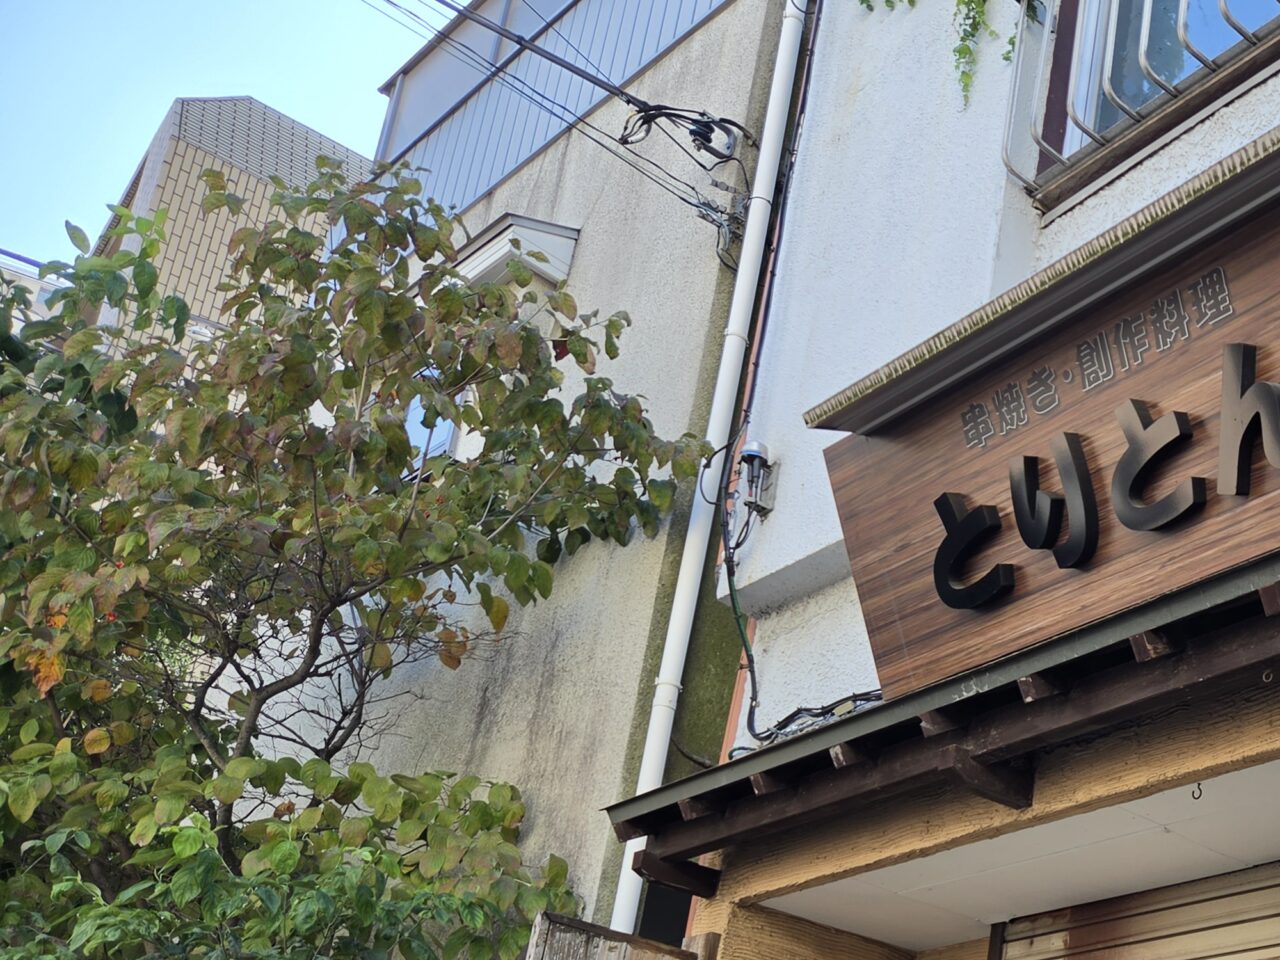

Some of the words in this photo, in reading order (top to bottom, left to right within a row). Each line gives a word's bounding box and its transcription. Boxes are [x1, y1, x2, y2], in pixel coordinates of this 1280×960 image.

[960, 265, 1235, 449] 串焼き・創作料理
